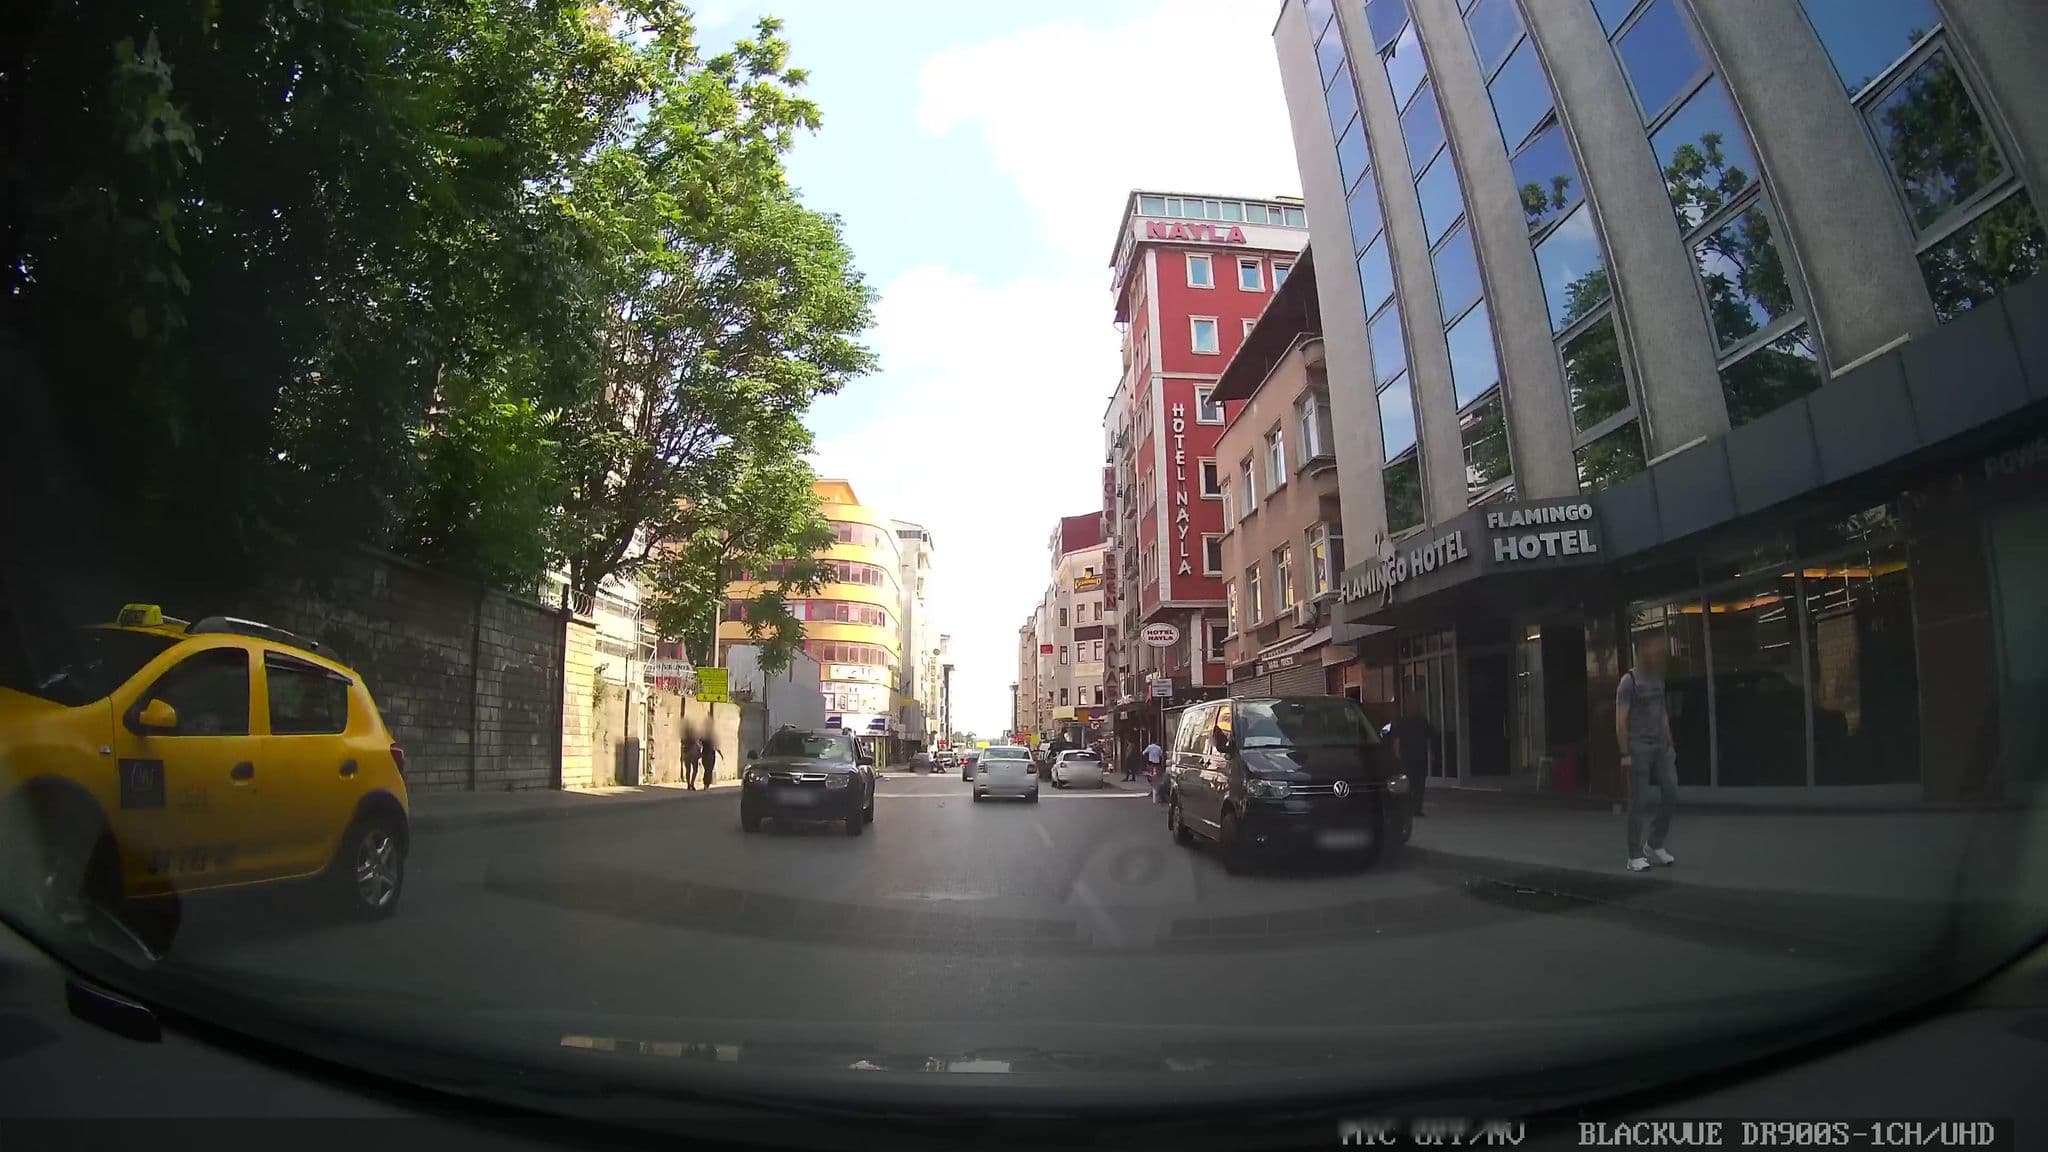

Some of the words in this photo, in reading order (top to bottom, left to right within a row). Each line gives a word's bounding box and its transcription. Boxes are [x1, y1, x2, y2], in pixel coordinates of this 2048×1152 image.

[1146, 220, 1247, 244] NAYLA
[1171, 402, 1186, 481] HOTEL
[1176, 491, 1192, 576] NAYLA
[1487, 503, 1593, 529] FLAMINGO
[1339, 559, 1407, 605] FLAMINGO
[1411, 530, 1469, 578] HOTEL
[1493, 529, 1597, 562] HOTEL
